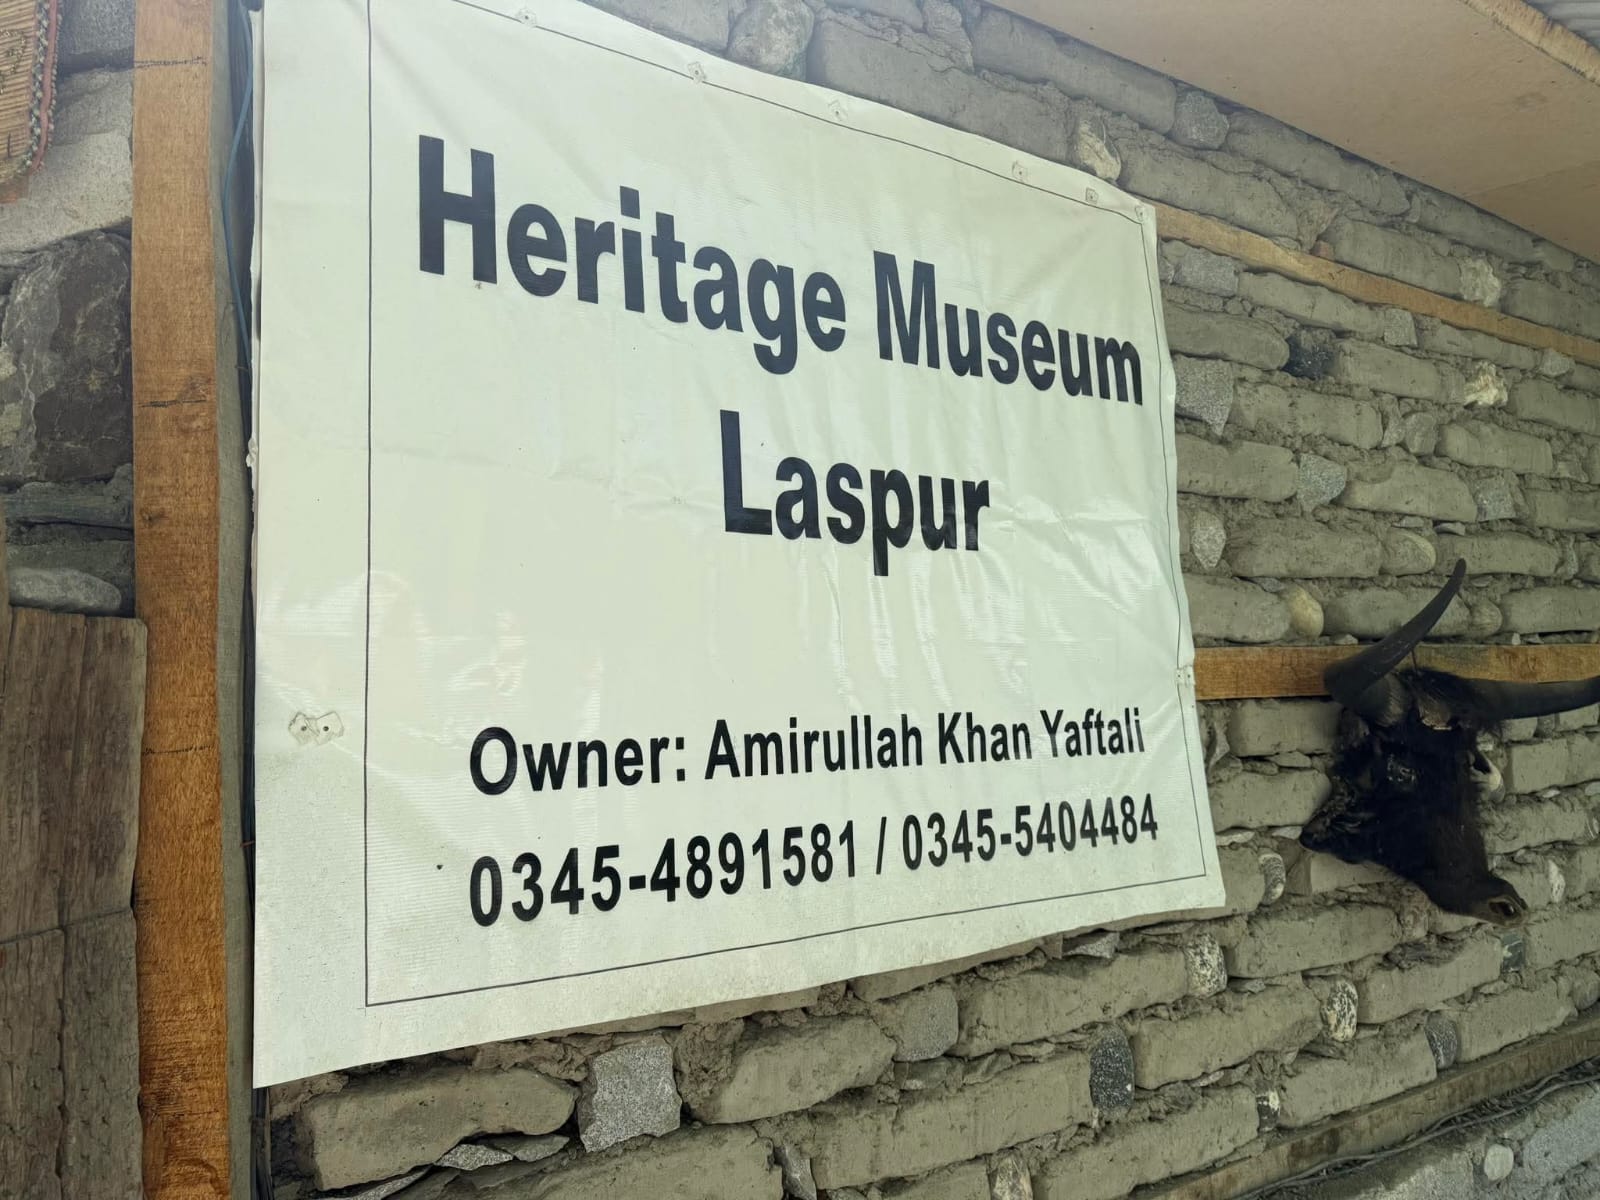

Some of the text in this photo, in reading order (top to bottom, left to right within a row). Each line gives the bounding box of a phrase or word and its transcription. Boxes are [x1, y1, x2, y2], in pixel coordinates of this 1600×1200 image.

[418, 134, 1143, 407] Heritage Museum
[719, 409, 990, 577] Laspur
[469, 707, 1145, 796] Owner: Amirullah Khan Yaftali
[469, 793, 1159, 928] 0345-4891581 / 0345-5404484
